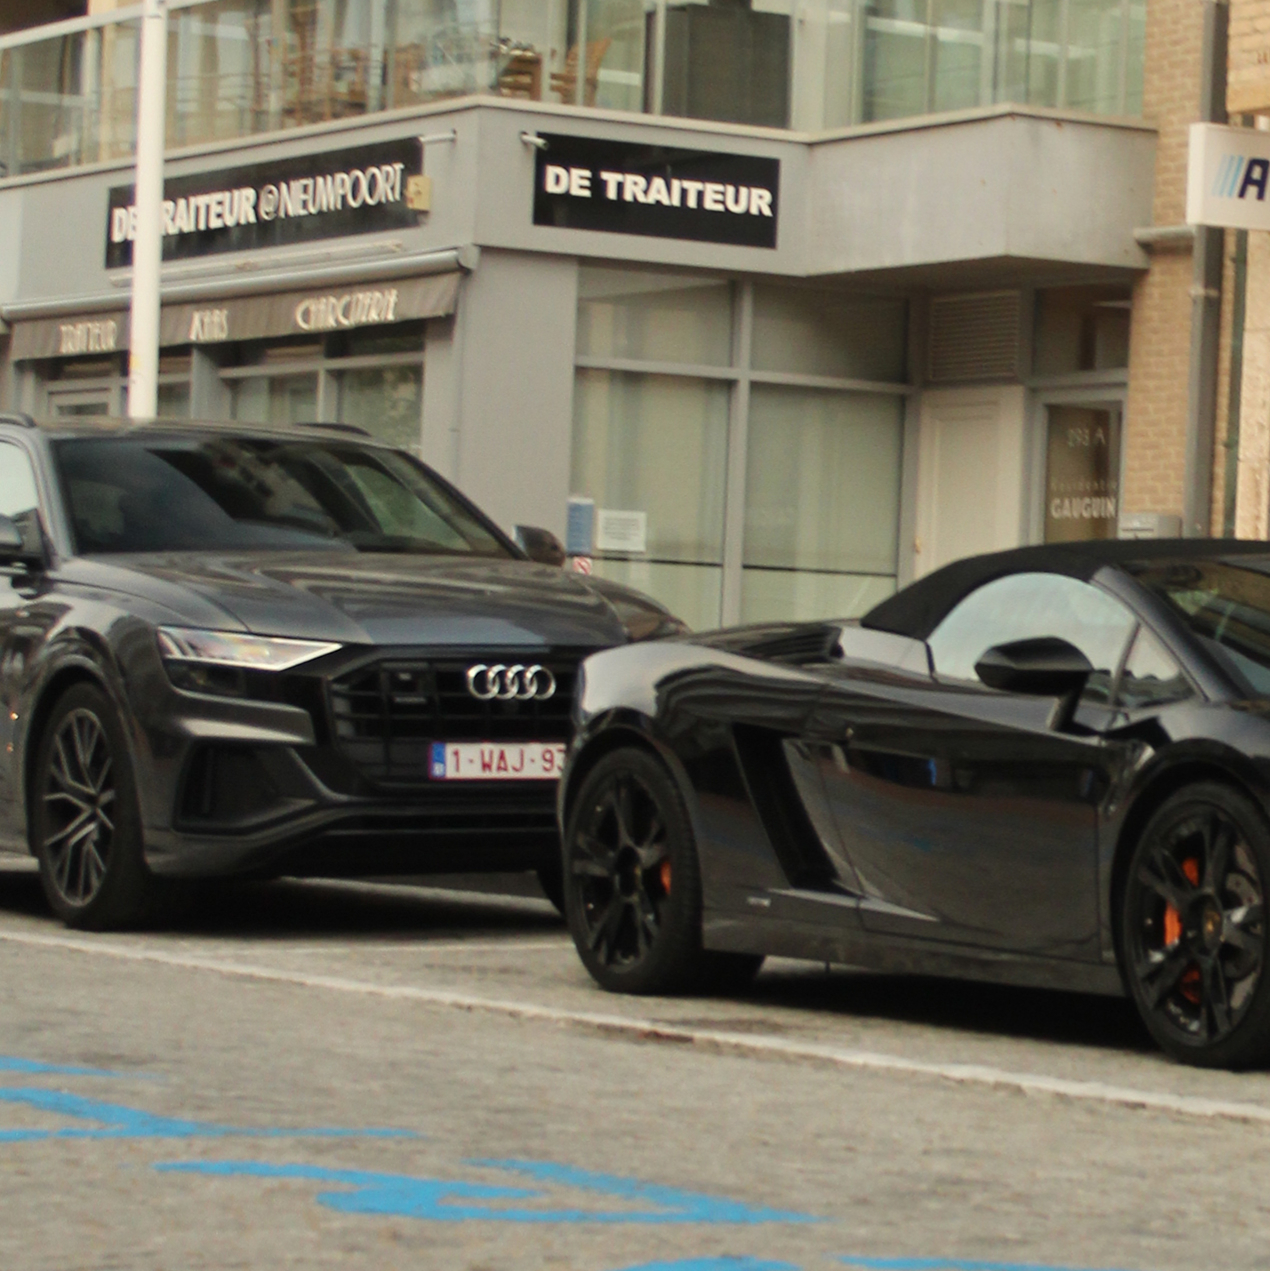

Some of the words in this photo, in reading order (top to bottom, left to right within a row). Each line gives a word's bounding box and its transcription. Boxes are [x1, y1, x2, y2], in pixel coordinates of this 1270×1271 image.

[545, 164, 592, 198] DE
[600, 171, 774, 217] TRAITEUR
[1238, 158, 1270, 201] A
[1051, 497, 1116, 519] GAUGUIN
